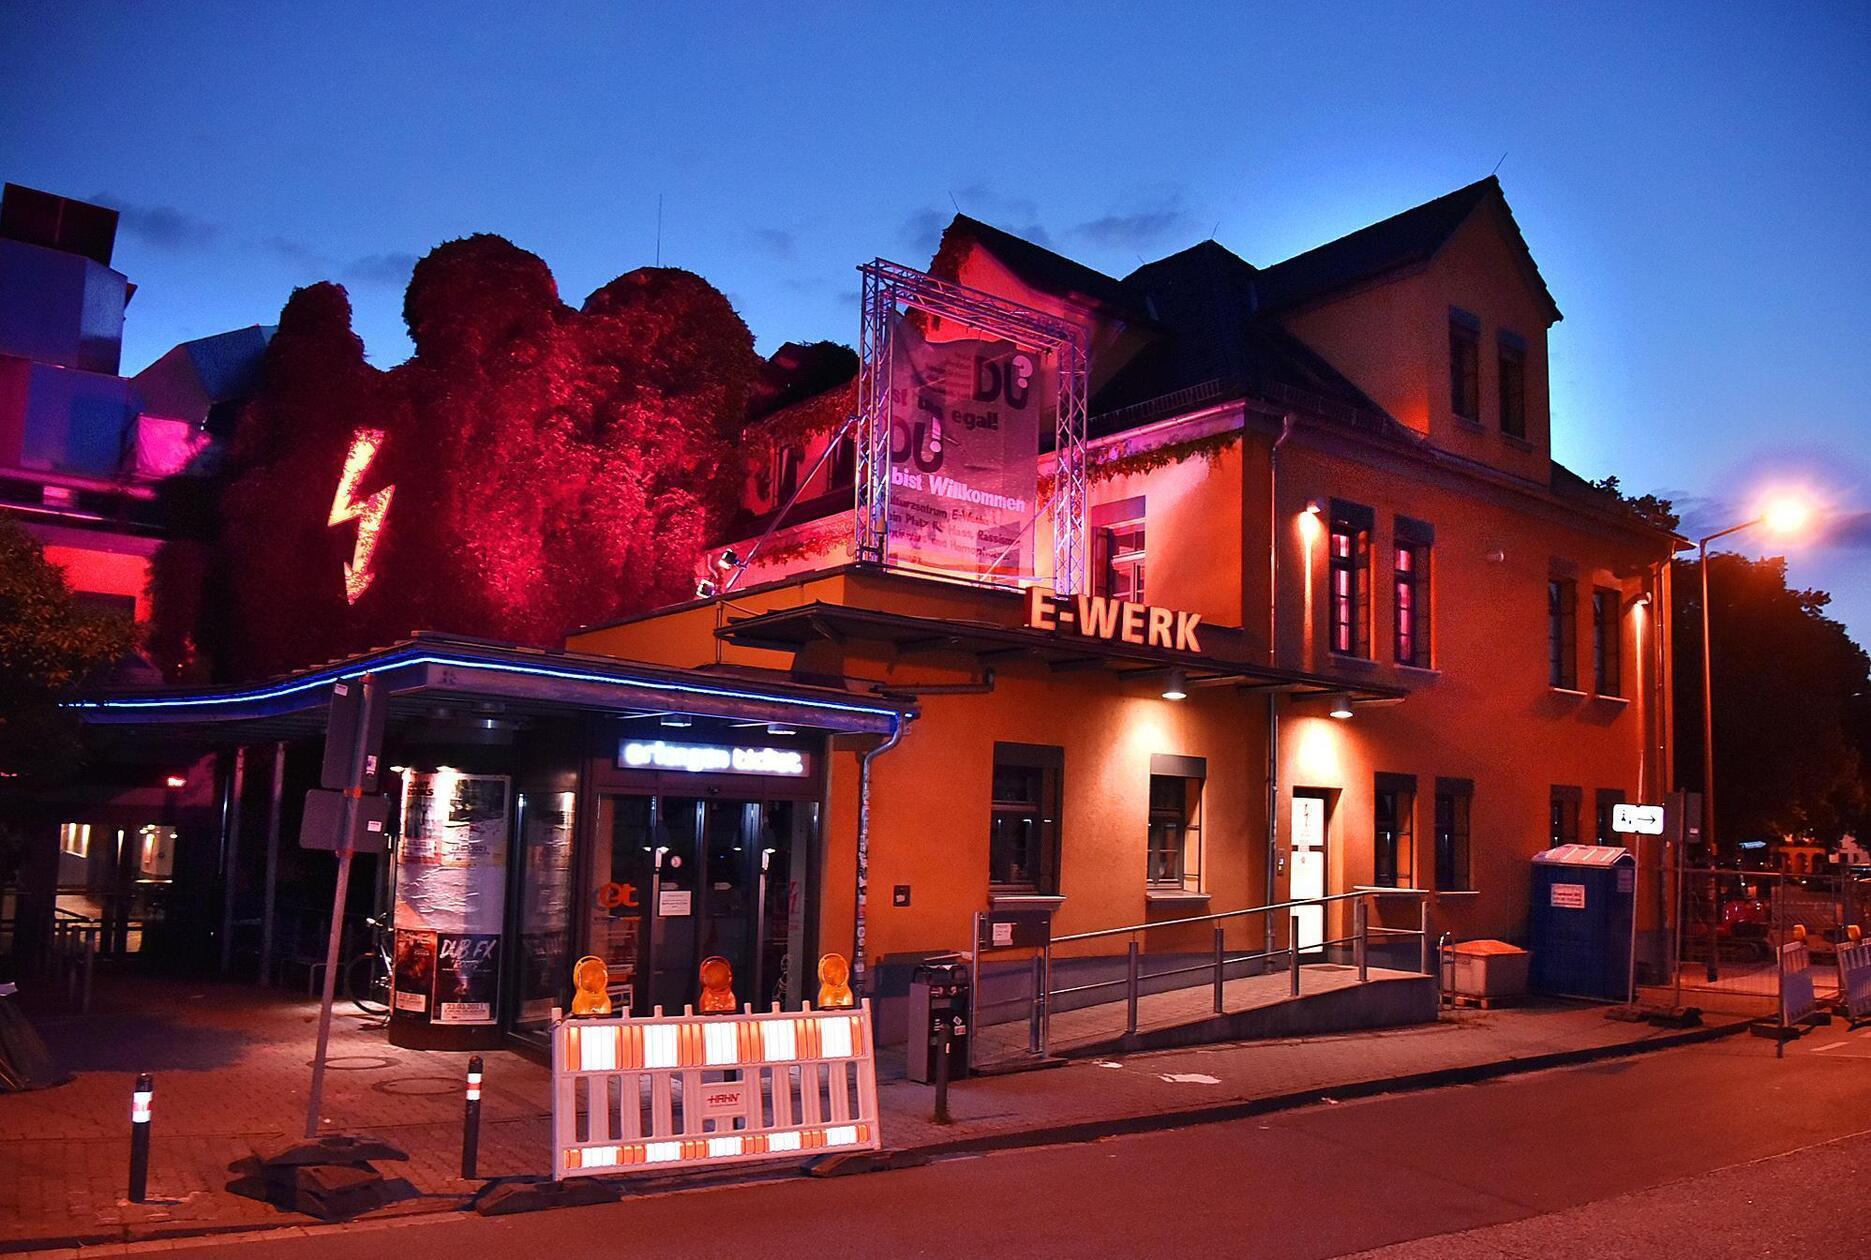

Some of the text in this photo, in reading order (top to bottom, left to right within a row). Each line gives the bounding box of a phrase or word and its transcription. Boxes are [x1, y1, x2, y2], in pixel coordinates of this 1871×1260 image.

[892, 466, 1025, 513] bist Willkommen
[1030, 586, 1202, 652] E-WERK
[439, 939, 497, 960] DUB FX
